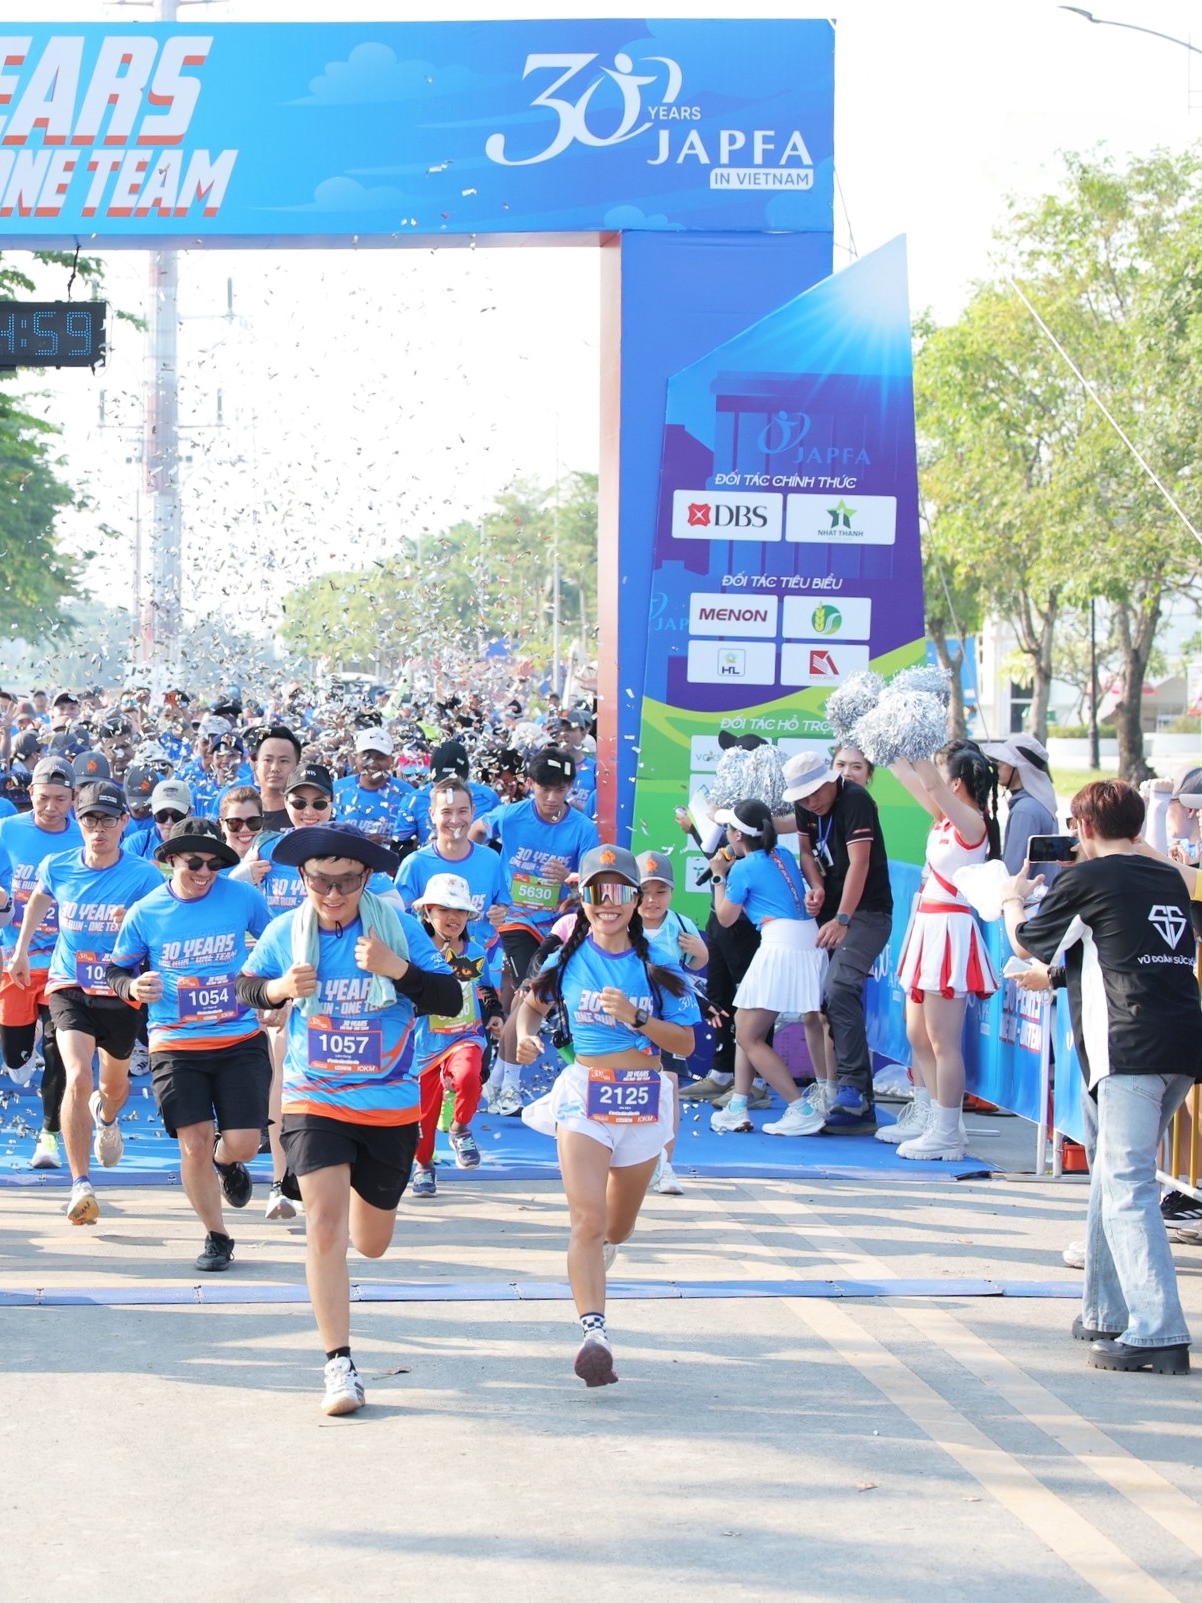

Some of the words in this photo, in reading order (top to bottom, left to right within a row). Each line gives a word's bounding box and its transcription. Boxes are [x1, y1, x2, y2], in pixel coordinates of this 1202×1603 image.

[648, 106, 702, 121] YEARS
[646, 129, 813, 167] JAPFA
[85, 150, 238, 217] TEAM
[713, 170, 730, 187] IN
[735, 171, 810, 188] VIETNAM
[792, 447, 872, 465] JAPFA
[715, 469, 739, 486] ĐỐI
[744, 472, 770, 486] TÁC
[772, 473, 815, 488] CHÍNH
[818, 474, 857, 489] THỨC
[714, 504, 768, 528] DBS
[722, 571, 748, 587] ĐỐI
[751, 574, 777, 588] TÁC
[779, 574, 810, 589] TIÊU
[812, 573, 843, 590] BIỂU
[699, 608, 768, 622] MENON
[720, 714, 746, 730] ĐỐI
[750, 716, 776, 730] TÁC
[515, 847, 533, 861] 30
[13, 864, 34, 880] 30
[518, 885, 552, 899] 5630
[162, 942, 181, 961] 30
[183, 933, 236, 959] YEARS
[189, 988, 229, 1006] 1054
[578, 990, 601, 1012] 30
[341, 1001, 362, 1016] ONE
[319, 1034, 369, 1054] 1057
[599, 1086, 649, 1105] 2125
